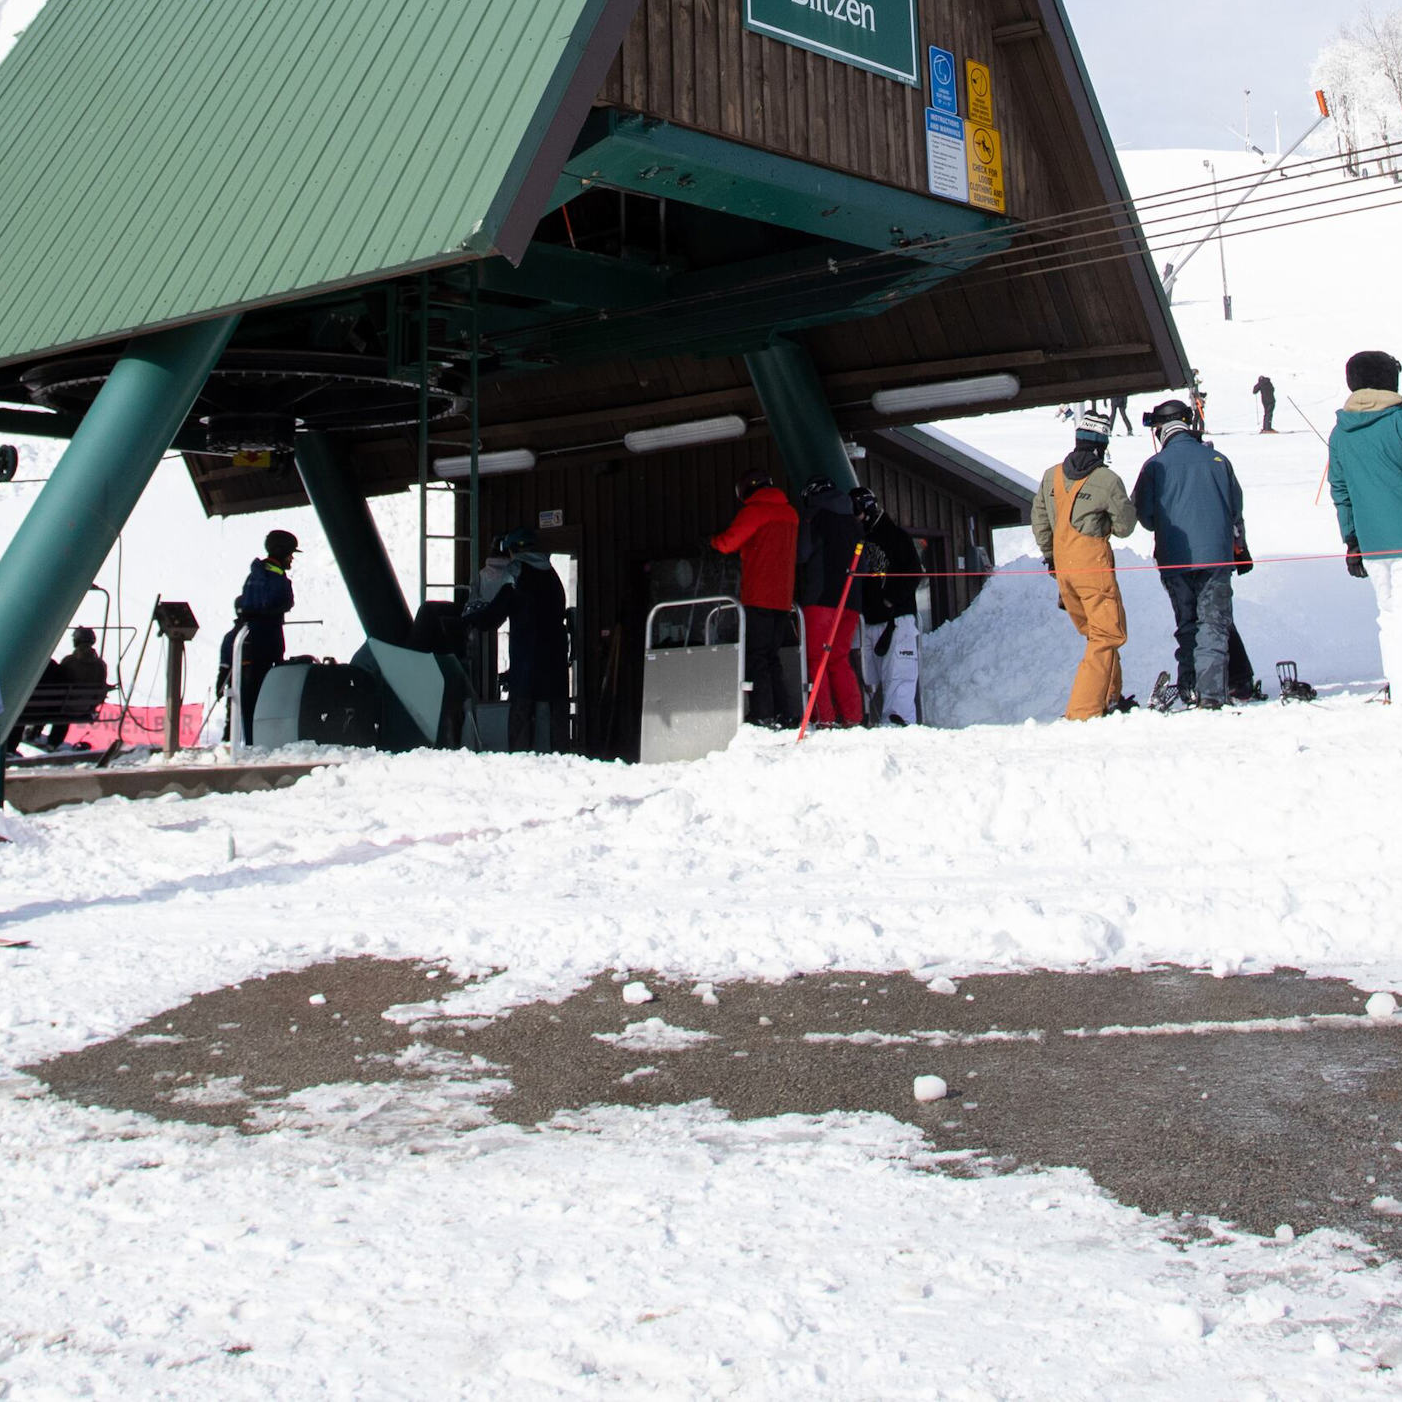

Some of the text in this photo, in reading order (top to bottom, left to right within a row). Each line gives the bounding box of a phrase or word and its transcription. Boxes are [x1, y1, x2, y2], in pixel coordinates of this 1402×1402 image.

[972, 163, 998, 178] CHECK FOR
[979, 174, 993, 187] LOOSE
[970, 182, 993, 196] CLOTHING
[154, 714, 193, 735] BR
